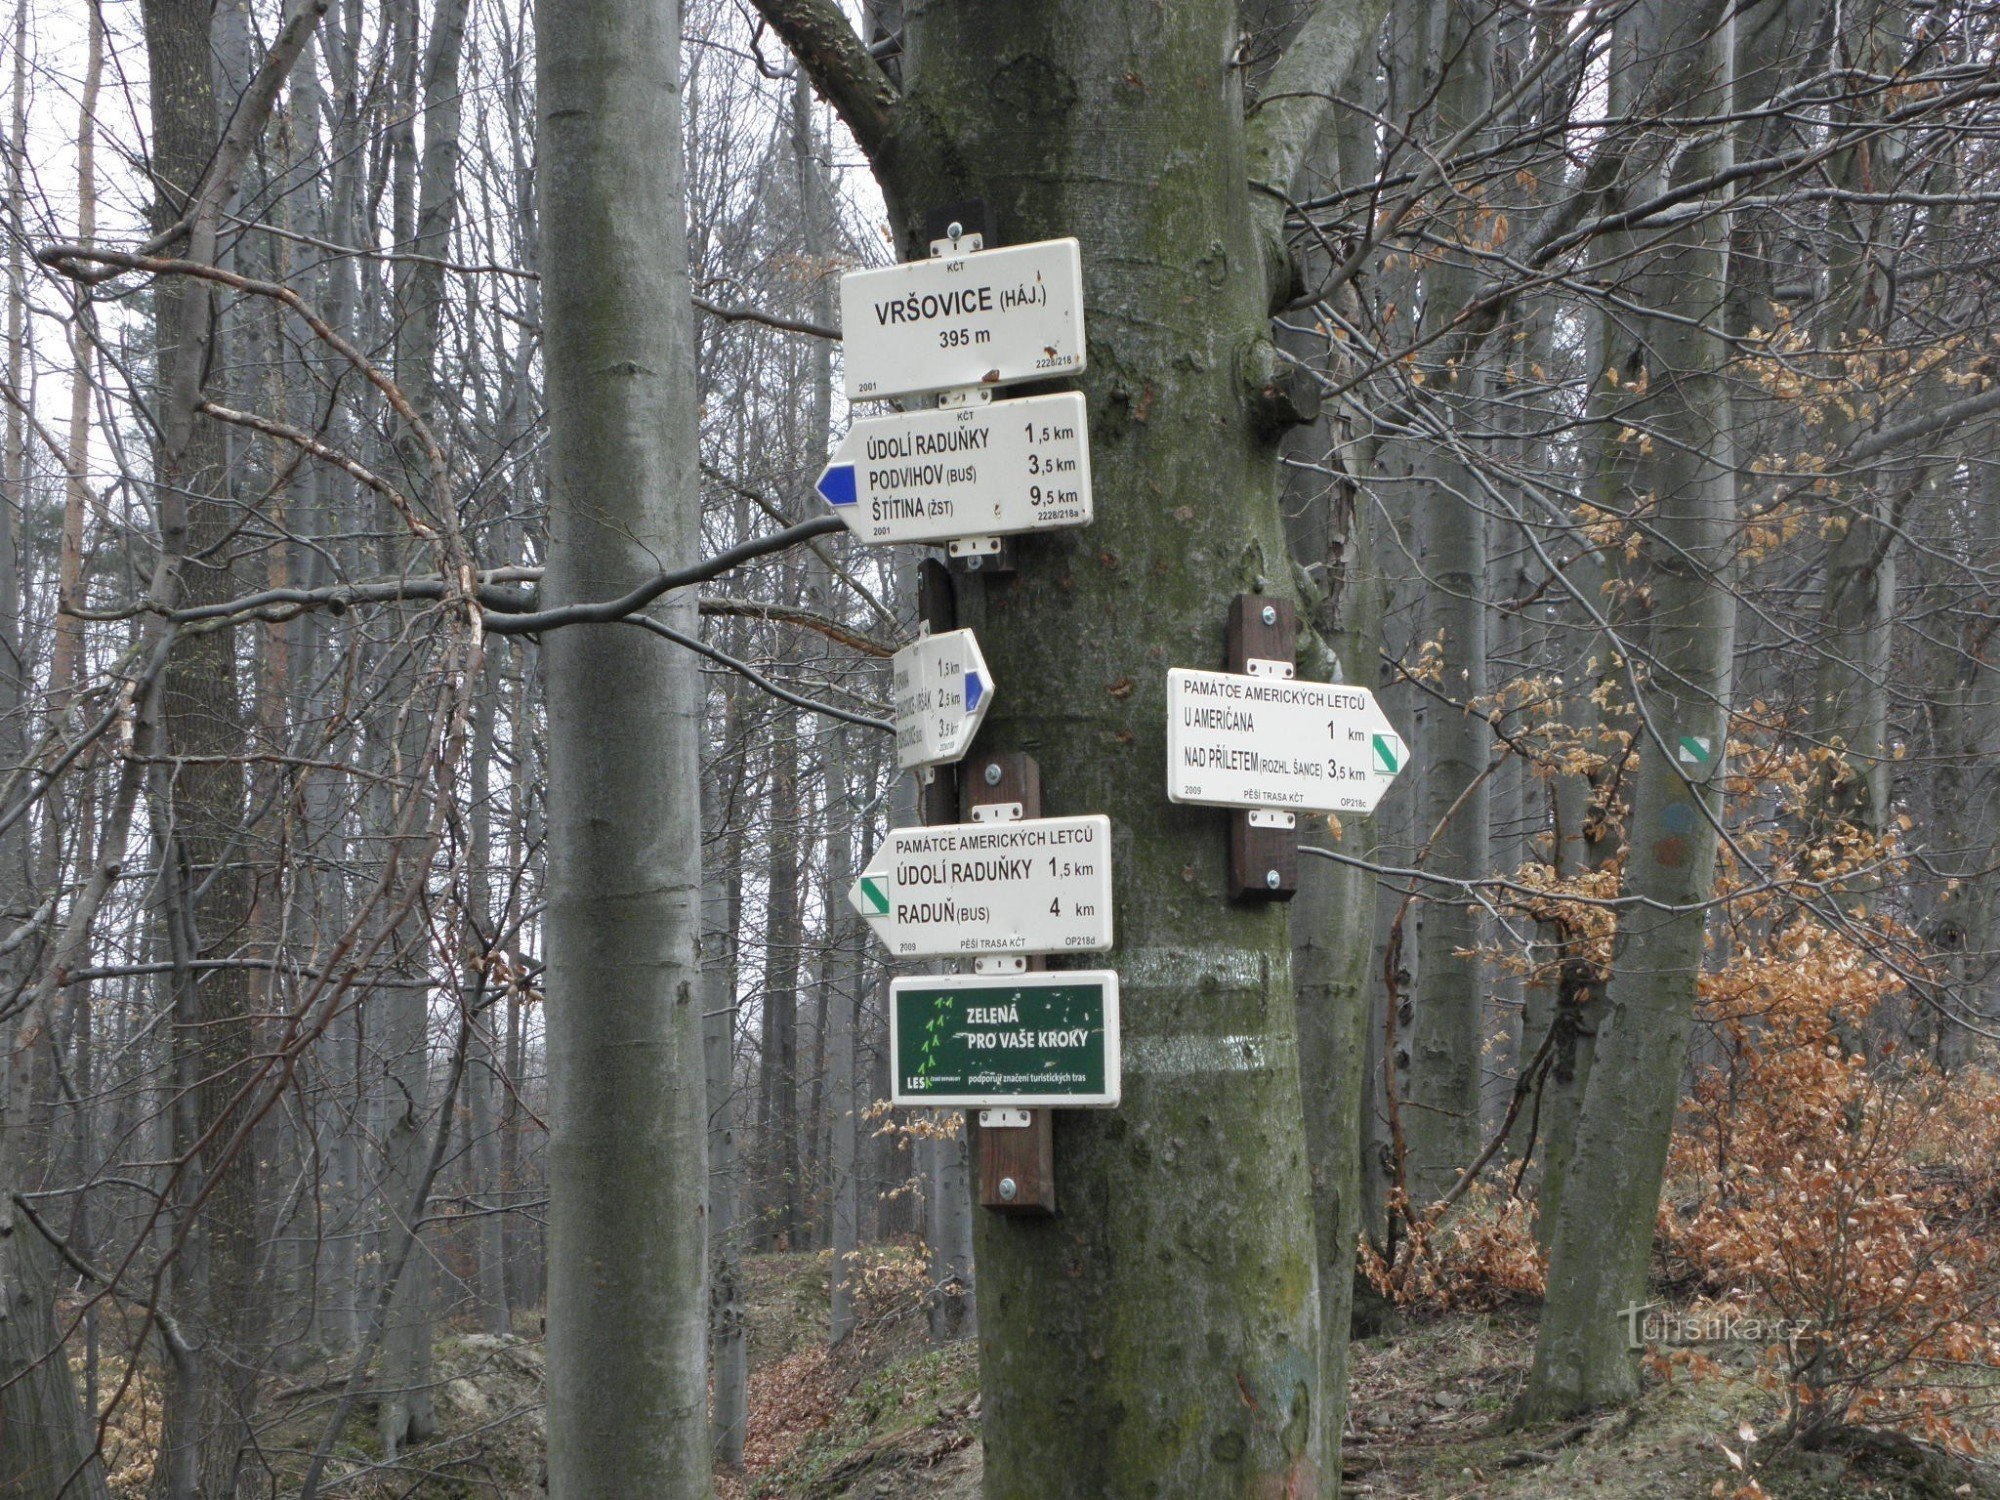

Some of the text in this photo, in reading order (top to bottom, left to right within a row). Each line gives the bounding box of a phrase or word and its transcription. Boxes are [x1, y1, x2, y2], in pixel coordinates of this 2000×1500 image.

[947, 261, 964, 273] KČT
[875, 284, 1047, 325] VRŠOVICE (HÁJ.)
[939, 328, 990, 348] 395 m
[859, 382, 877, 392] 2001
[957, 411, 974, 421] KČT
[867, 422, 1074, 460] ÚDOLÍ RADUŇKY 1,5 km
[869, 454, 1076, 491] PODVIHOV (BUS) 3,5 km
[872, 486, 1078, 521] ŠTÍTINA (ŽST) 9,5 km
[1038, 509, 1079, 521] 2228/218a
[873, 527, 891, 536] 2001
[951, 662, 960, 674] km
[951, 693, 960, 704] km
[1184, 680, 1365, 711] PAMÁTCE AMERICKÝCH LETCŮ
[1184, 706, 1364, 741] U AMERIČANA 1 km
[1184, 744, 1365, 781] NAD PŘÍLETEM (ROZHL. ŠANCE) 3,5 km
[1185, 785, 1201, 795] 2009
[1244, 788, 1304, 803] PĚŠÍ TRASA KČT
[1340, 798, 1366, 808] OP218c
[896, 825, 1093, 854] PAMÁTCE AMERICKÝCH LETCŮ
[897, 855, 1093, 886] ÚDOLÍ RADUŇKY 1,5 km
[898, 896, 1095, 925] RADUŇ (BUS) 4 km
[899, 942, 916, 951] 2009
[960, 937, 1026, 949] PĚŠÍ TRASA KČT
[1065, 936, 1096, 946] OP218d
[967, 1004, 1019, 1024] ZELENÁ
[968, 1028, 1088, 1049] PRO VAŠE KROKY
[1003, 1074, 1029, 1083] značení
[1030, 1072, 1071, 1085] turistických
[1072, 1072, 1086, 1082] tras
